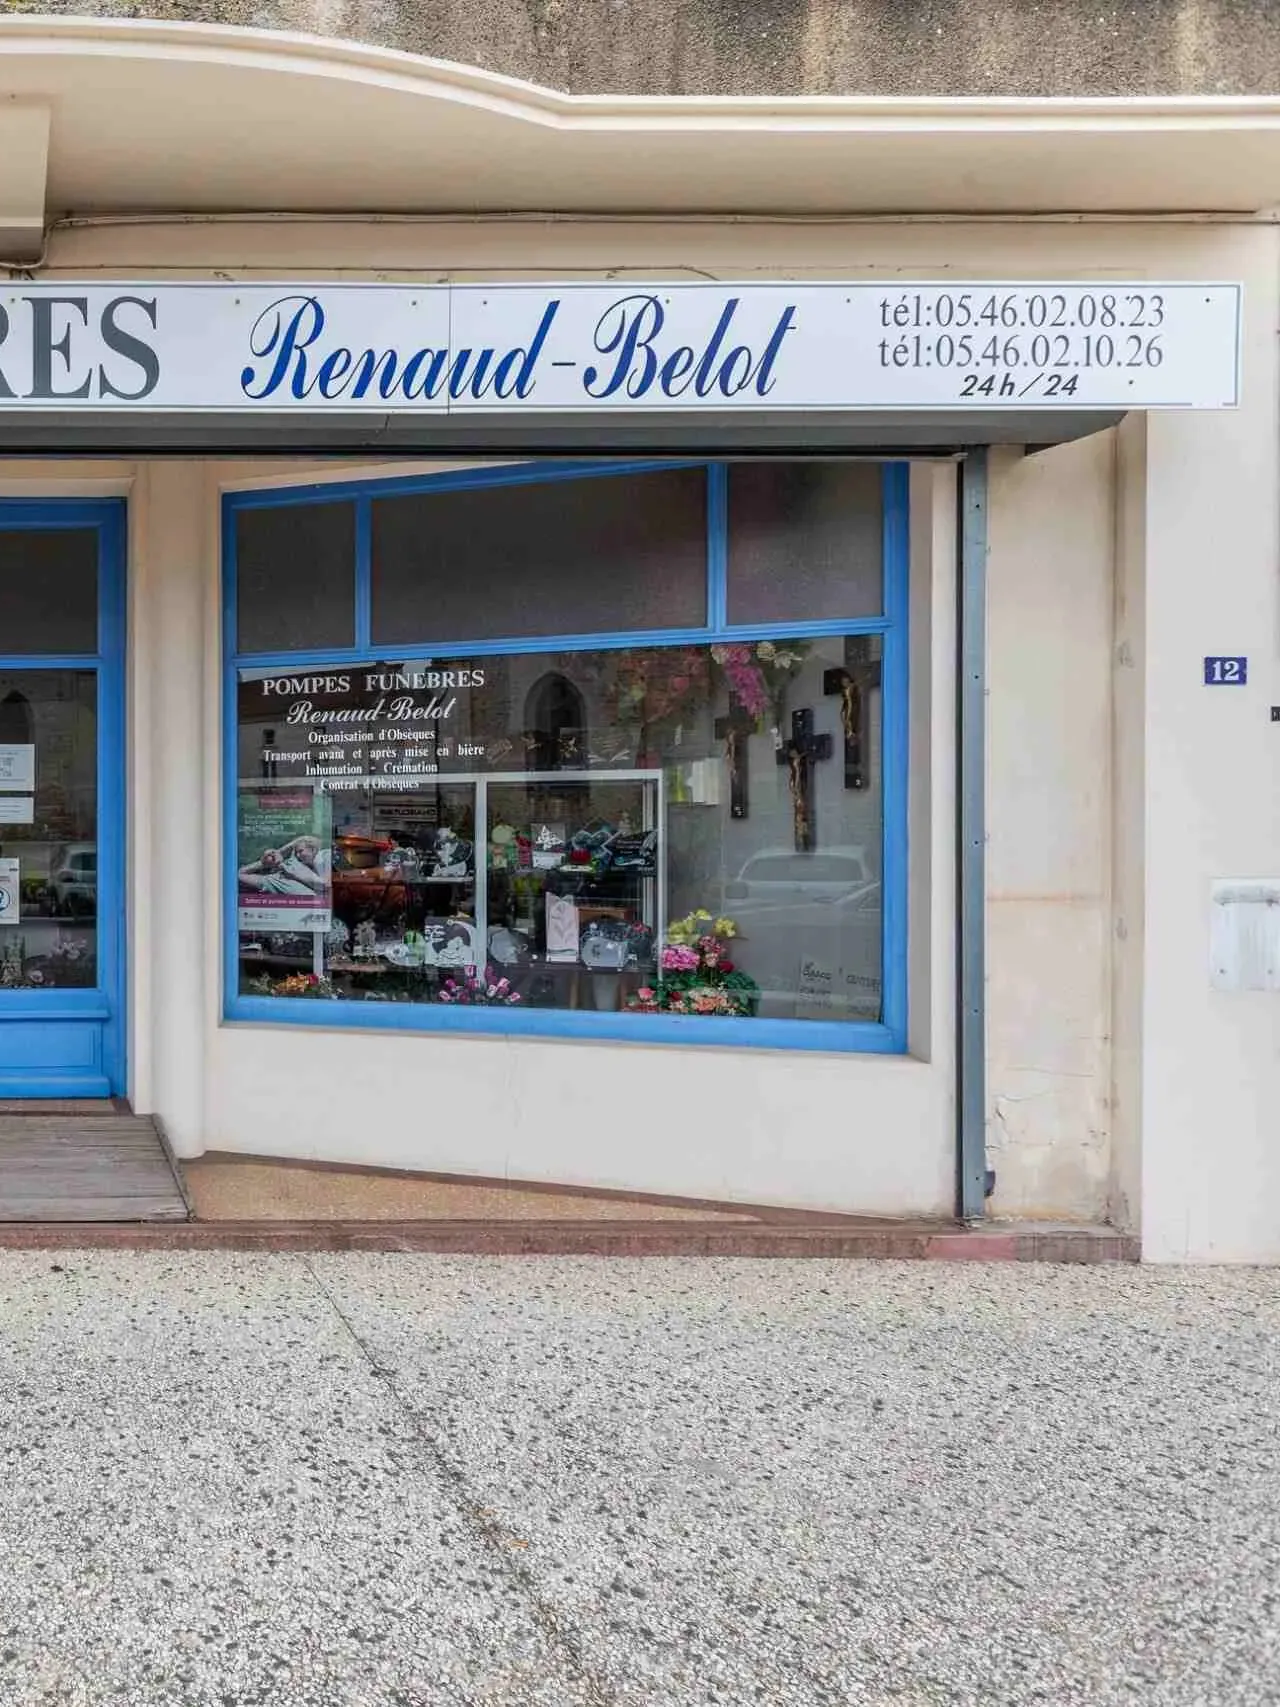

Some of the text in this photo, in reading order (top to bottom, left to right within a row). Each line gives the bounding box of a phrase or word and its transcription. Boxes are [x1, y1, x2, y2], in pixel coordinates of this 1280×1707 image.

[1212, 660, 1240, 681] 12
[261, 670, 485, 696] POMPES FUNEBRES
[308, 728, 436, 745] Organisation d'Obsèques
[263, 744, 485, 762] Transport avant et après mise en bière
[305, 763, 363, 776] Inhumation
[383, 761, 438, 774] Crémation
[320, 778, 359, 791] Contrat
